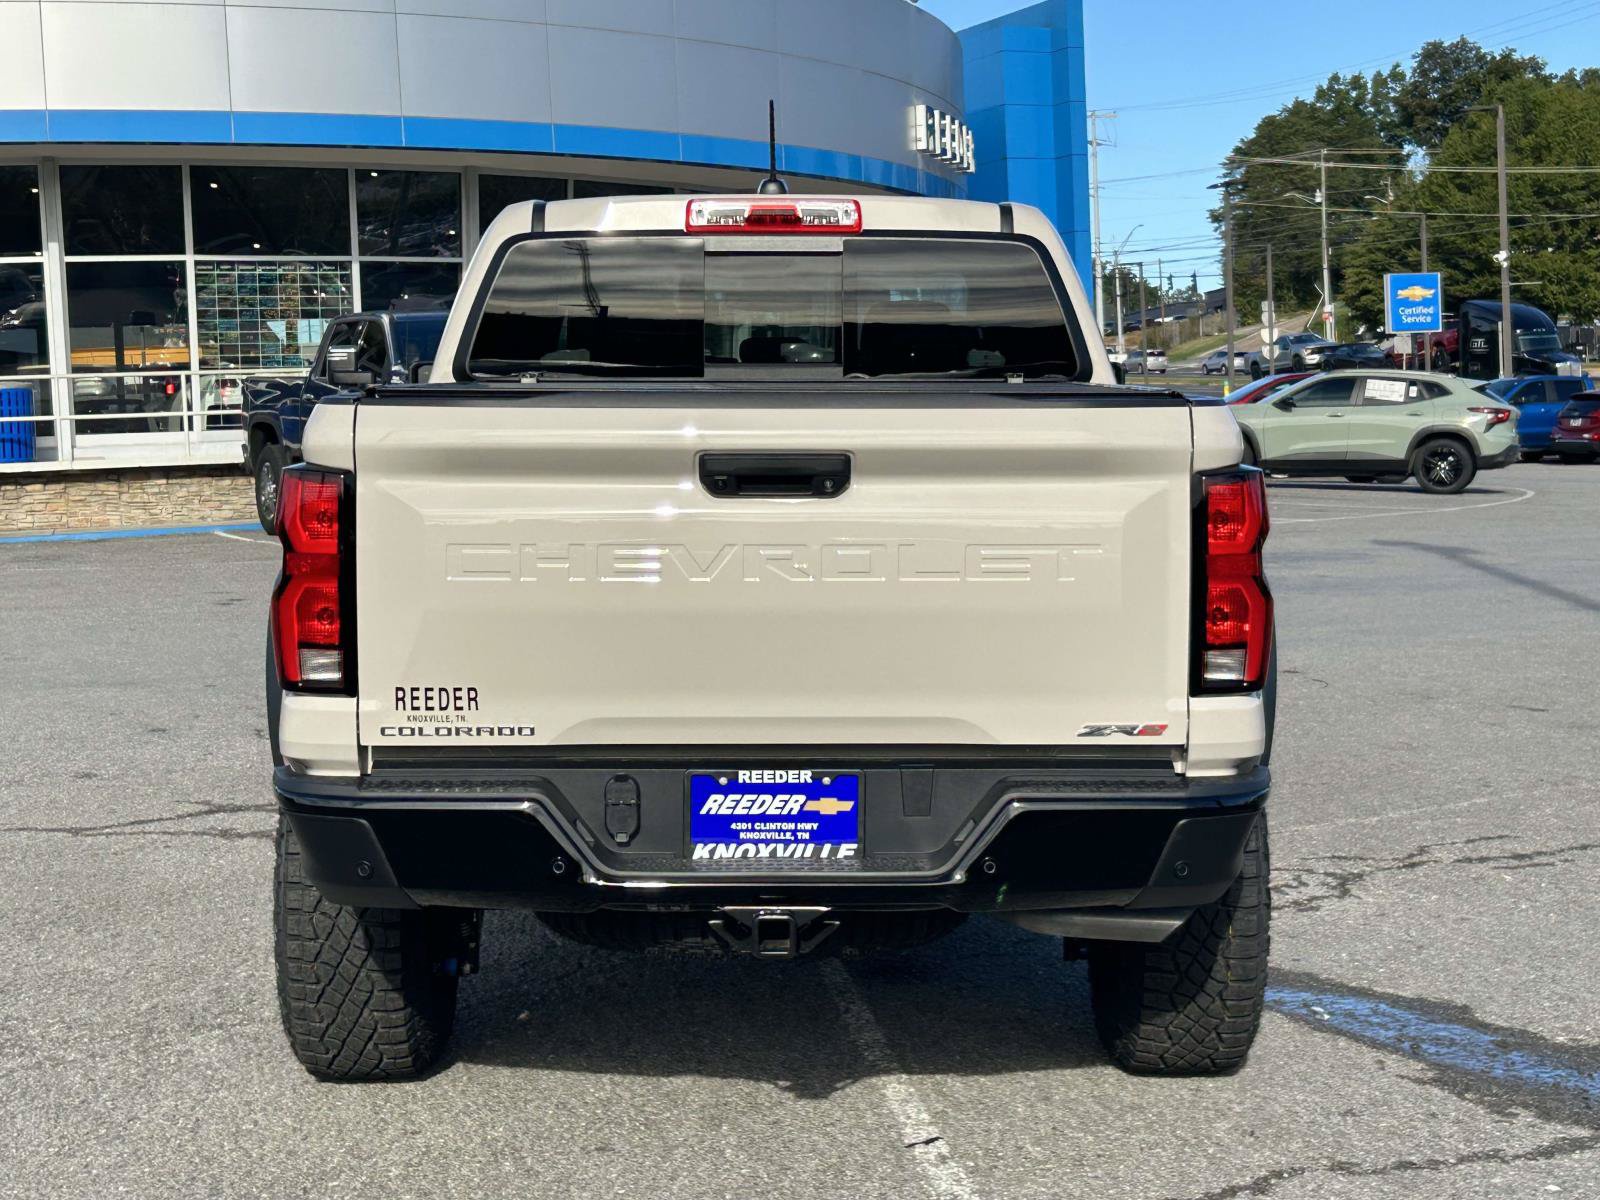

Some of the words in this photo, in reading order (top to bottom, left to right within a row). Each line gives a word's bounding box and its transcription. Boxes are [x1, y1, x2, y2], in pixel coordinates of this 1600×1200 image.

[1398, 306, 1434, 315] Certified
[1401, 314, 1432, 323] Service
[446, 542, 1105, 583] CHEVROLET
[395, 687, 479, 711] REEDER
[380, 726, 535, 737] COLORADO
[1077, 724, 1168, 737] ZR2
[737, 769, 813, 784] REEDER
[699, 793, 807, 815] REEDER
[754, 822, 795, 831] CLINTON
[797, 822, 819, 831] HWY
[739, 831, 795, 841] KNOXVILLE,
[796, 831, 810, 840] TN
